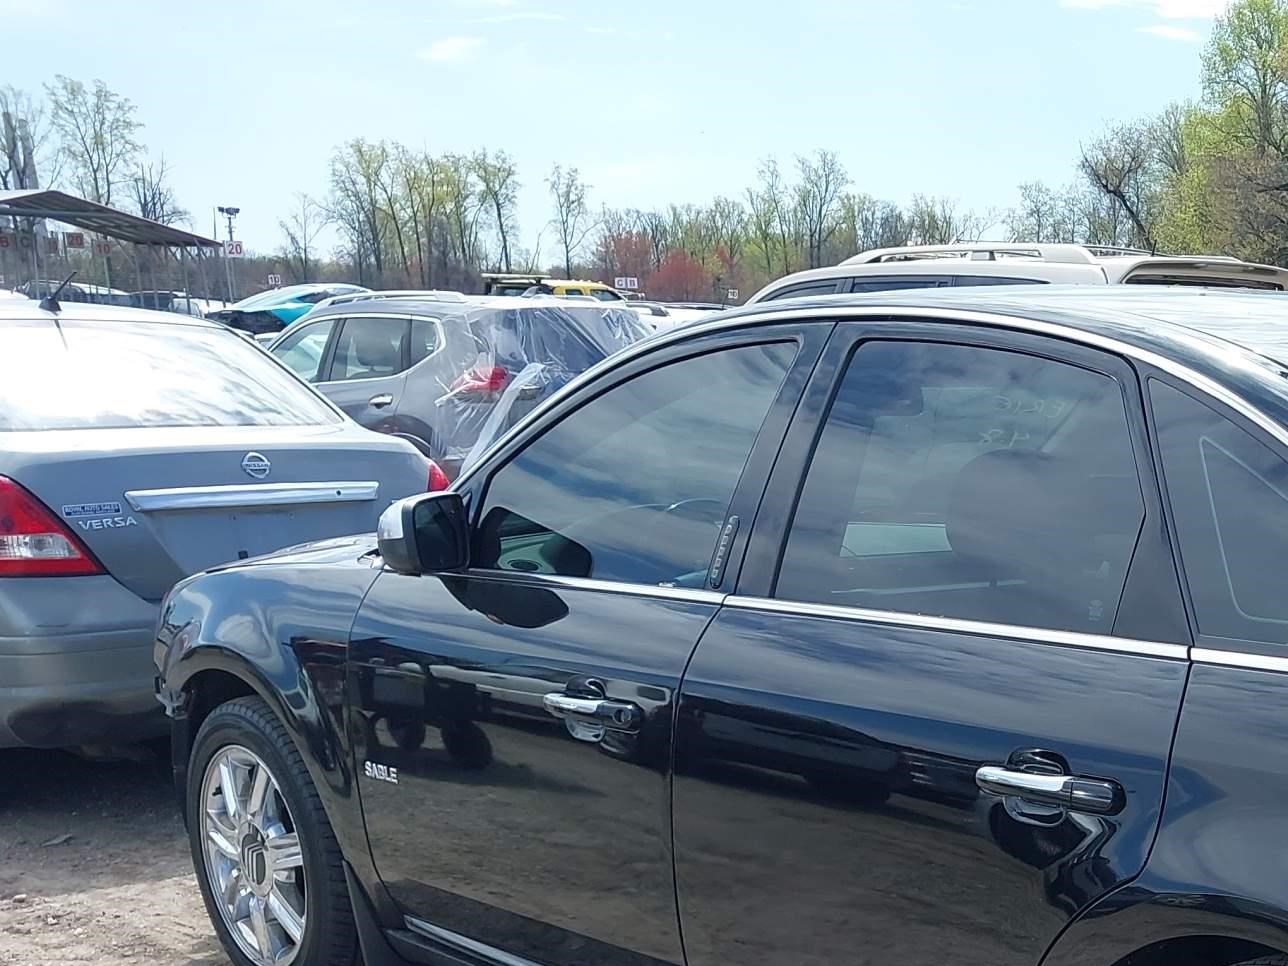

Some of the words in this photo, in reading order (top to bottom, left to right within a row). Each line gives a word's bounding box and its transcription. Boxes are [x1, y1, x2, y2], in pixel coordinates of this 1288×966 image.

[96, 243, 111, 255] 10
[227, 243, 242, 255] 20
[77, 516, 138, 531] VERSA
[363, 760, 399, 785] SABLE
